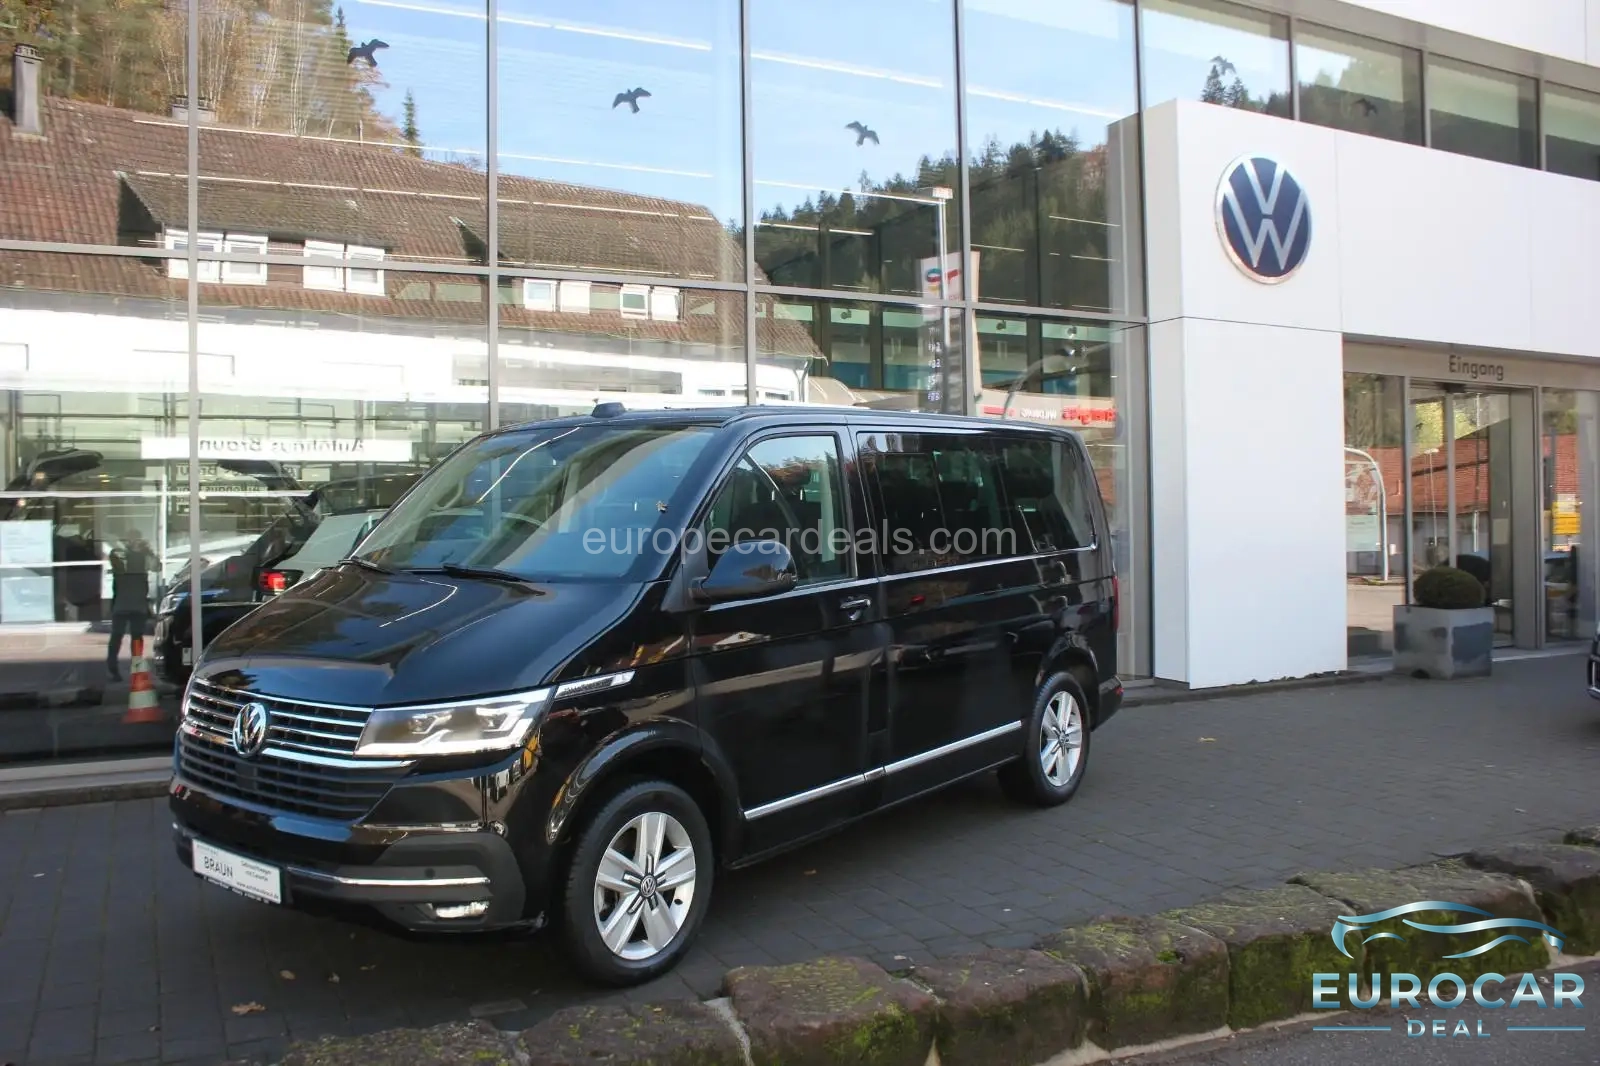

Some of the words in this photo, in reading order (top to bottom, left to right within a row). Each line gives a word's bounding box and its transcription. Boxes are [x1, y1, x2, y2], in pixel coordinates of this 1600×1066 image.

[1216, 154, 1311, 281] VW
[1448, 354, 1504, 381] Eingang
[203, 855, 234, 878] BRAUN
